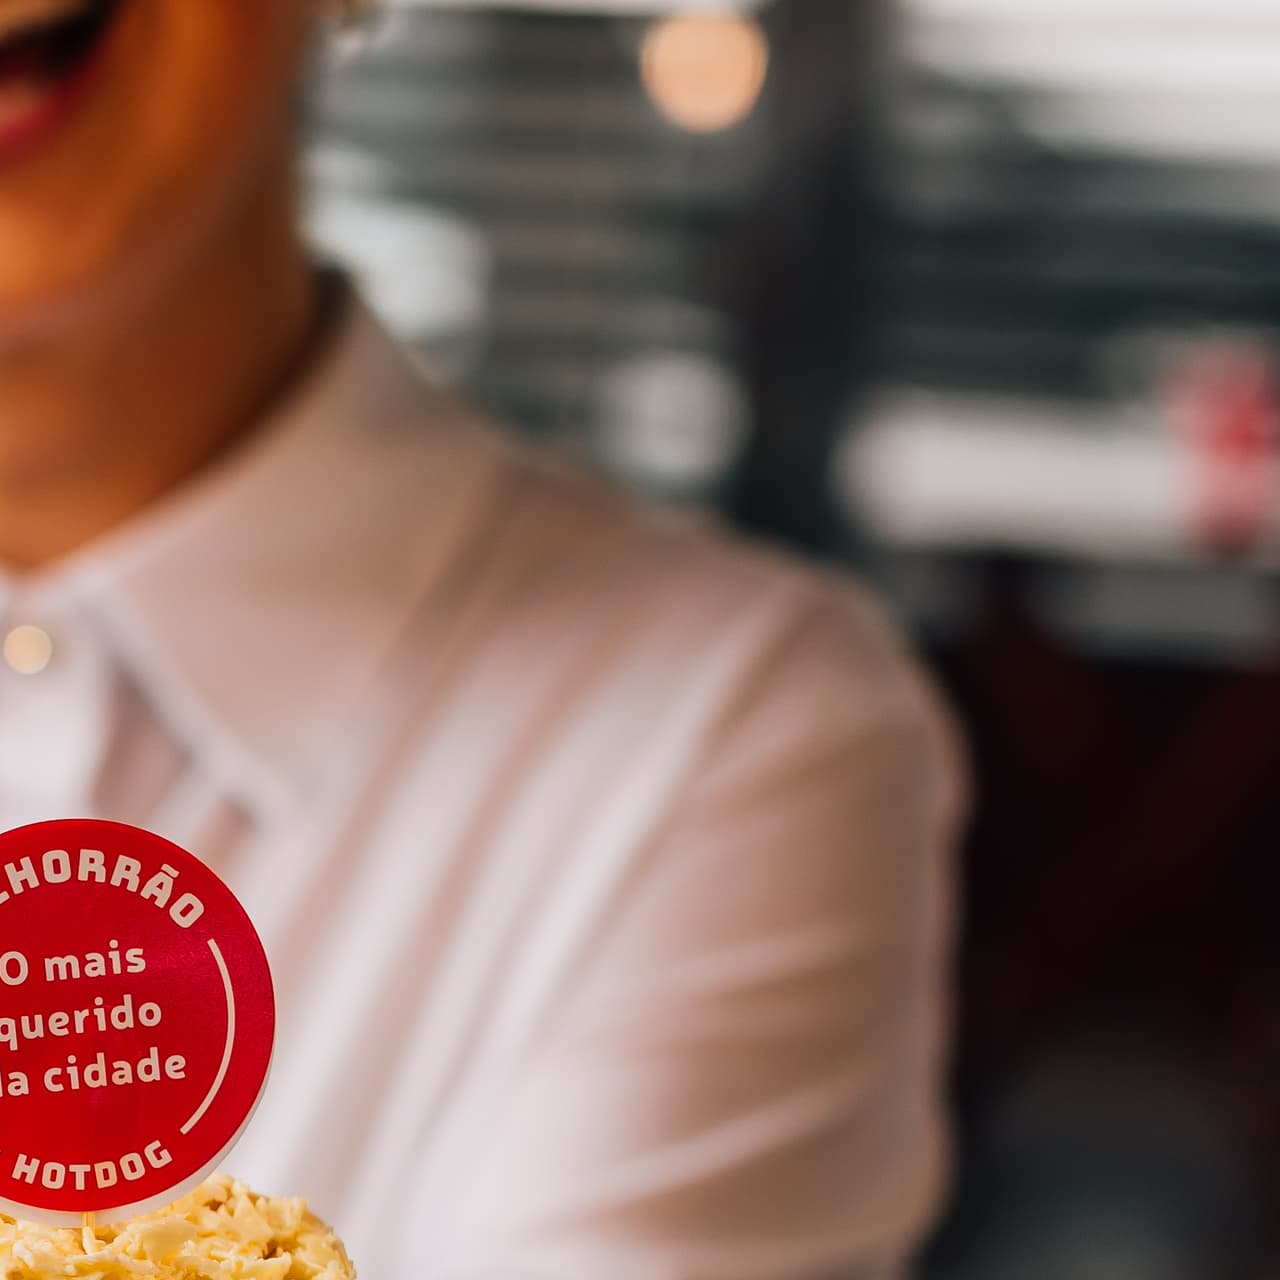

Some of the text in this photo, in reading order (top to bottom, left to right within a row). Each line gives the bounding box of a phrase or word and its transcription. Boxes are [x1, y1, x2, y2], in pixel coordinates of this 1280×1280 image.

[44, 939, 146, 982] mais
[43, 1046, 187, 1093] cidade
[12, 1140, 173, 1191] HOTDOG
